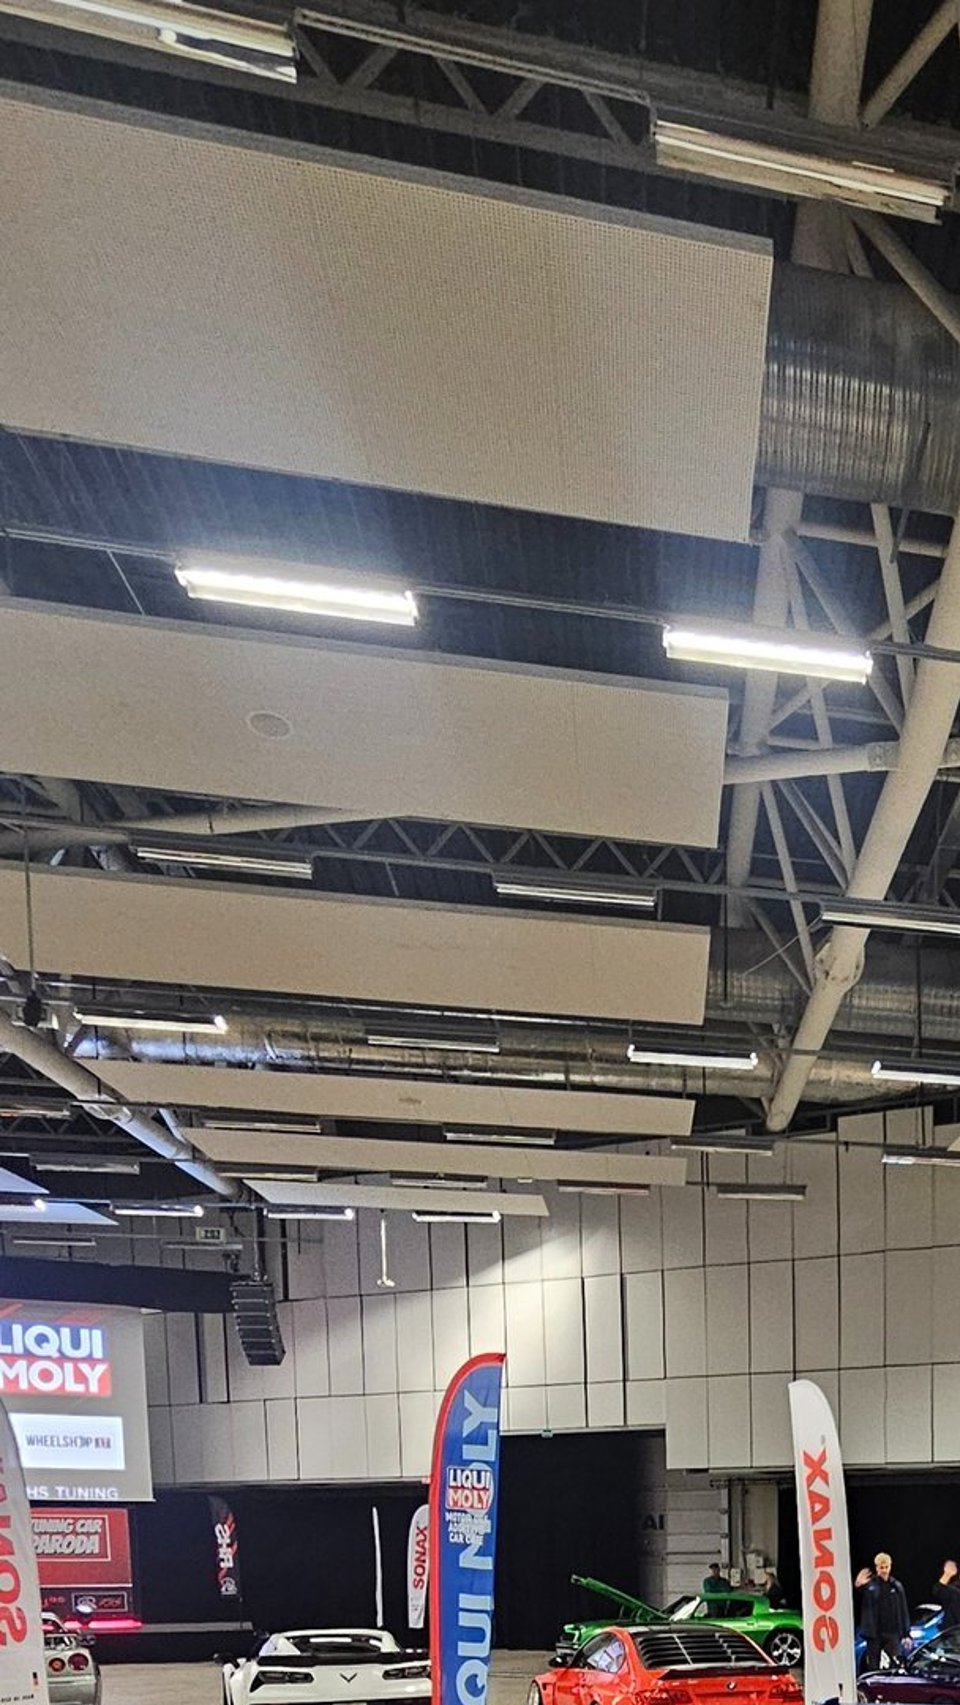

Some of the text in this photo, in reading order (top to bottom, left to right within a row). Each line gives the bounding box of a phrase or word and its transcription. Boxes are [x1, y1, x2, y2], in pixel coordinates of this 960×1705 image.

[0, 1359, 109, 1393] MOLY
[449, 1468, 490, 1490] LIQUI
[56, 1486, 118, 1499] TUNING
[447, 1488, 489, 1510] MOLY
[414, 1526, 428, 1590] SONAX
